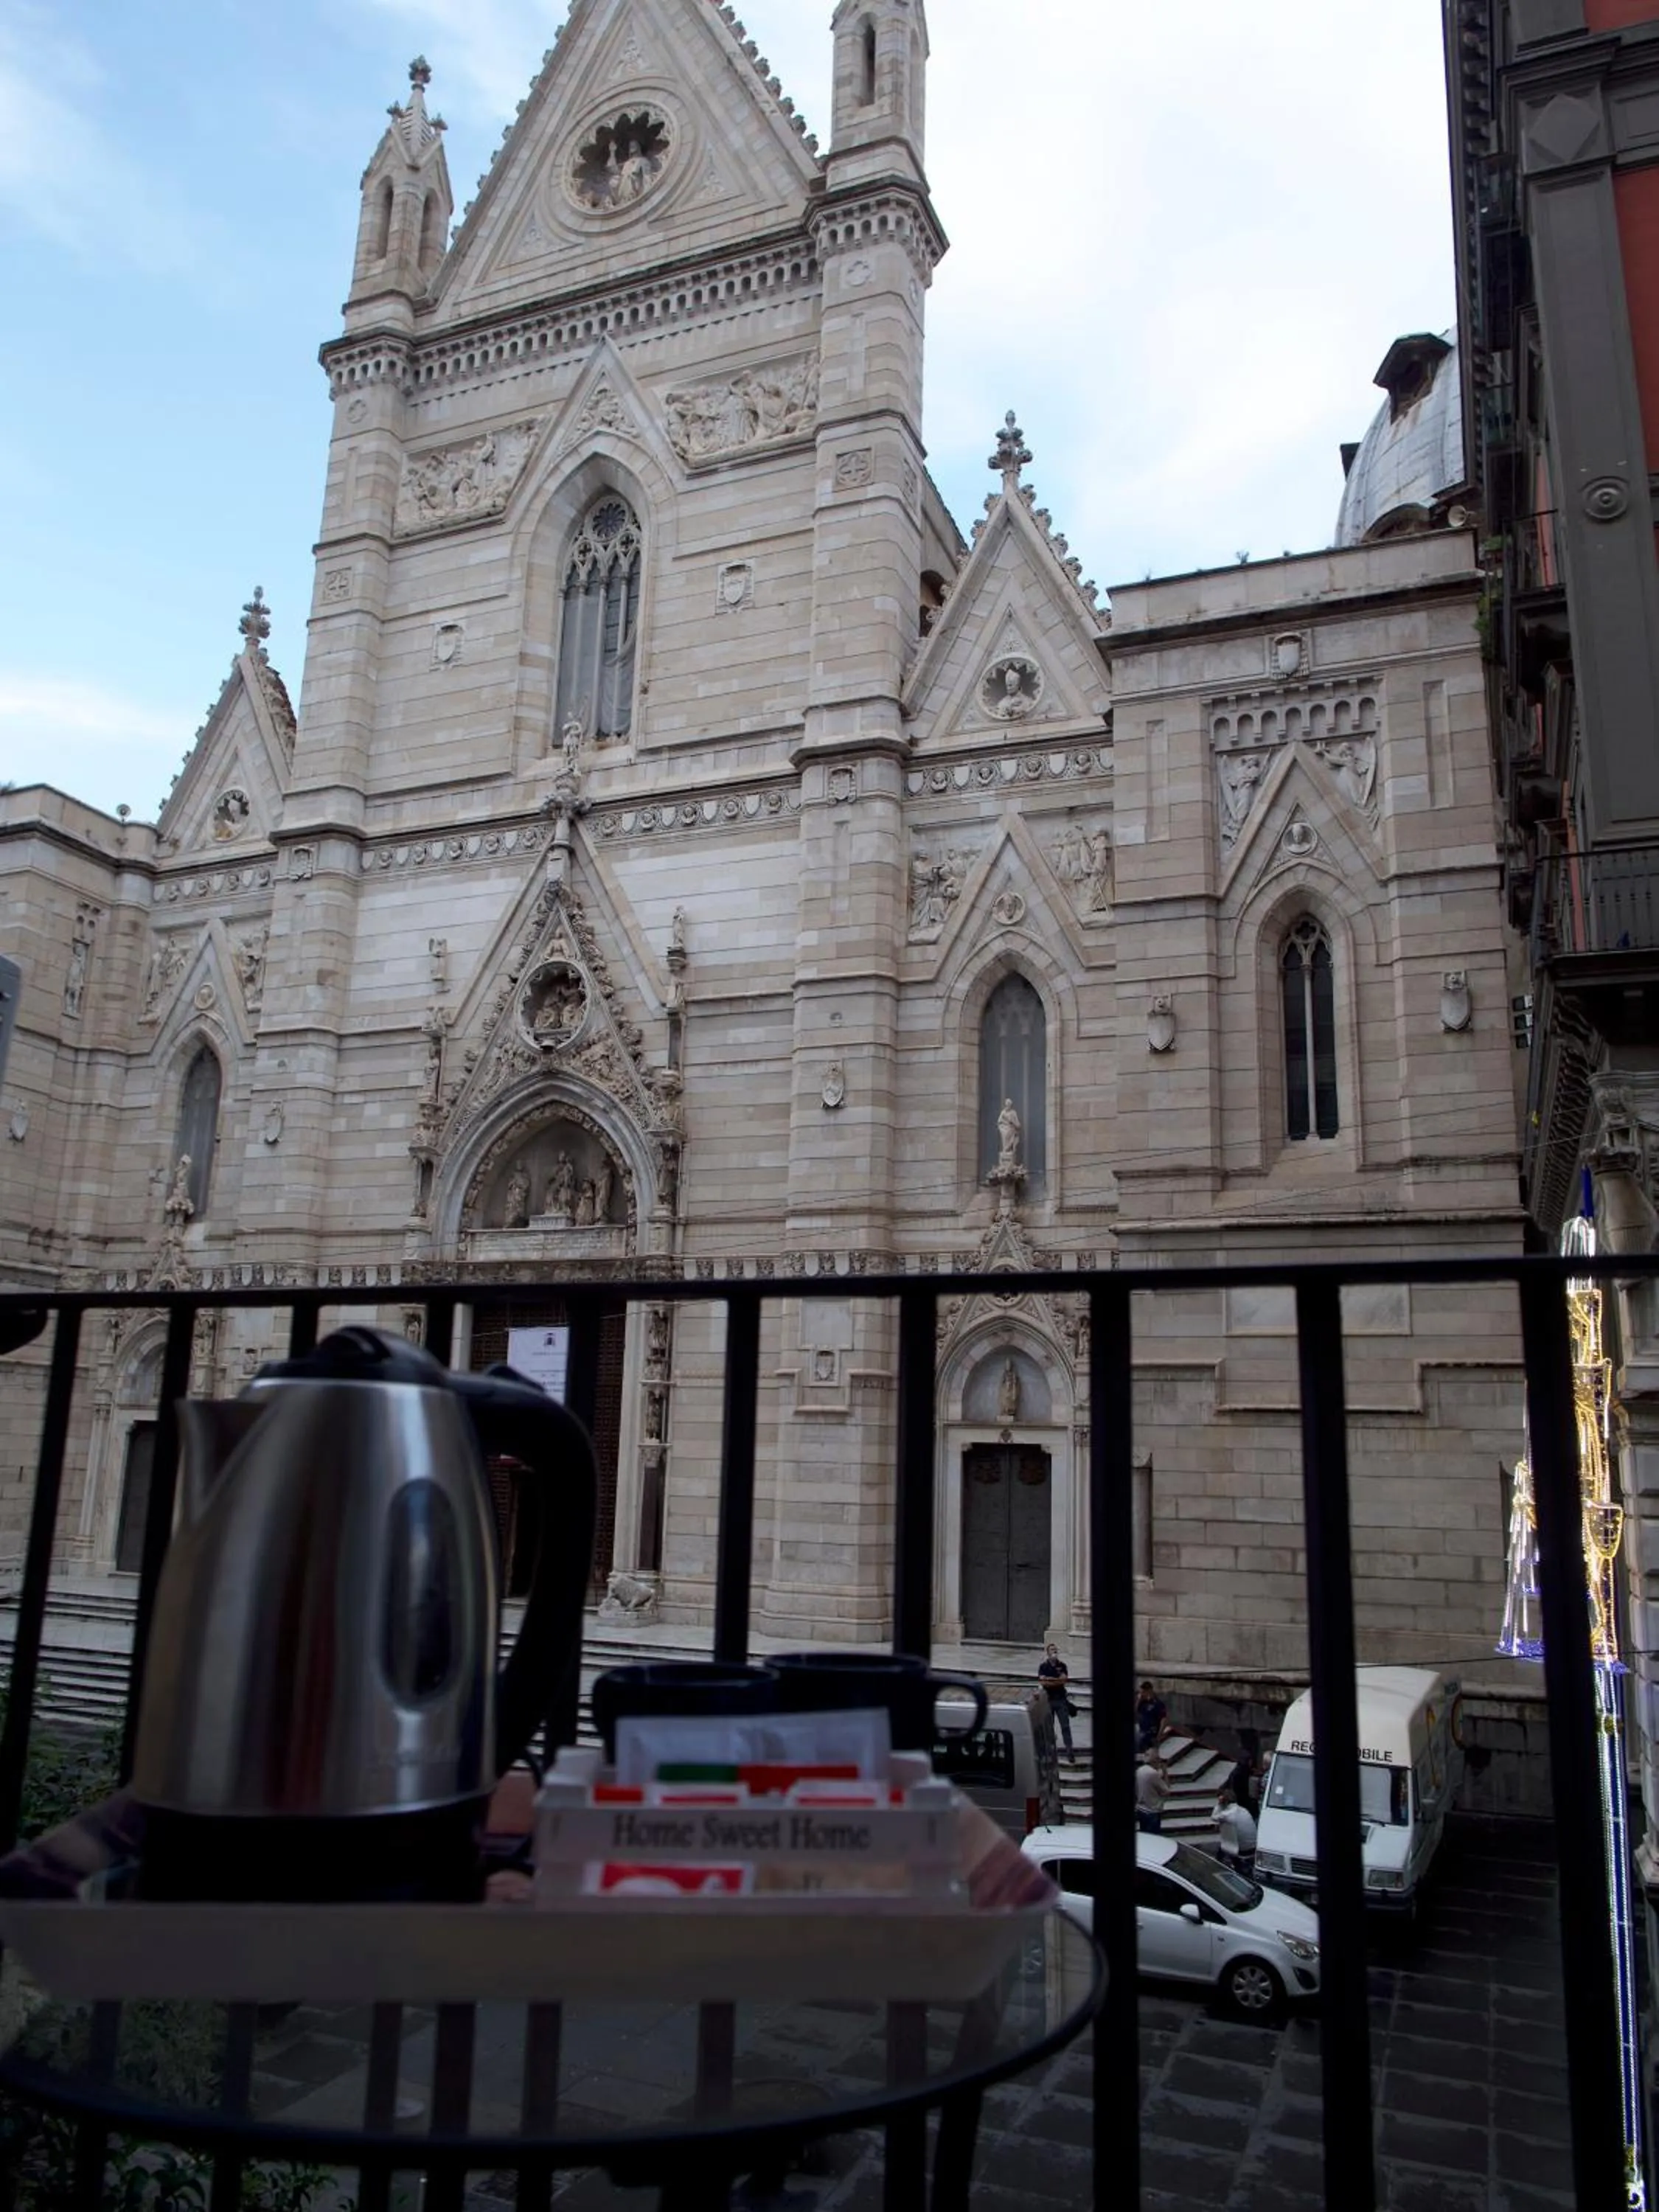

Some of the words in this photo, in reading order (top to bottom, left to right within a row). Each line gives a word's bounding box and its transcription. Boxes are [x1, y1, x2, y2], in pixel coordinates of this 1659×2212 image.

[613, 1812, 695, 1848] Home
[703, 1813, 780, 1849] Sweet
[790, 1815, 872, 1850] Home
